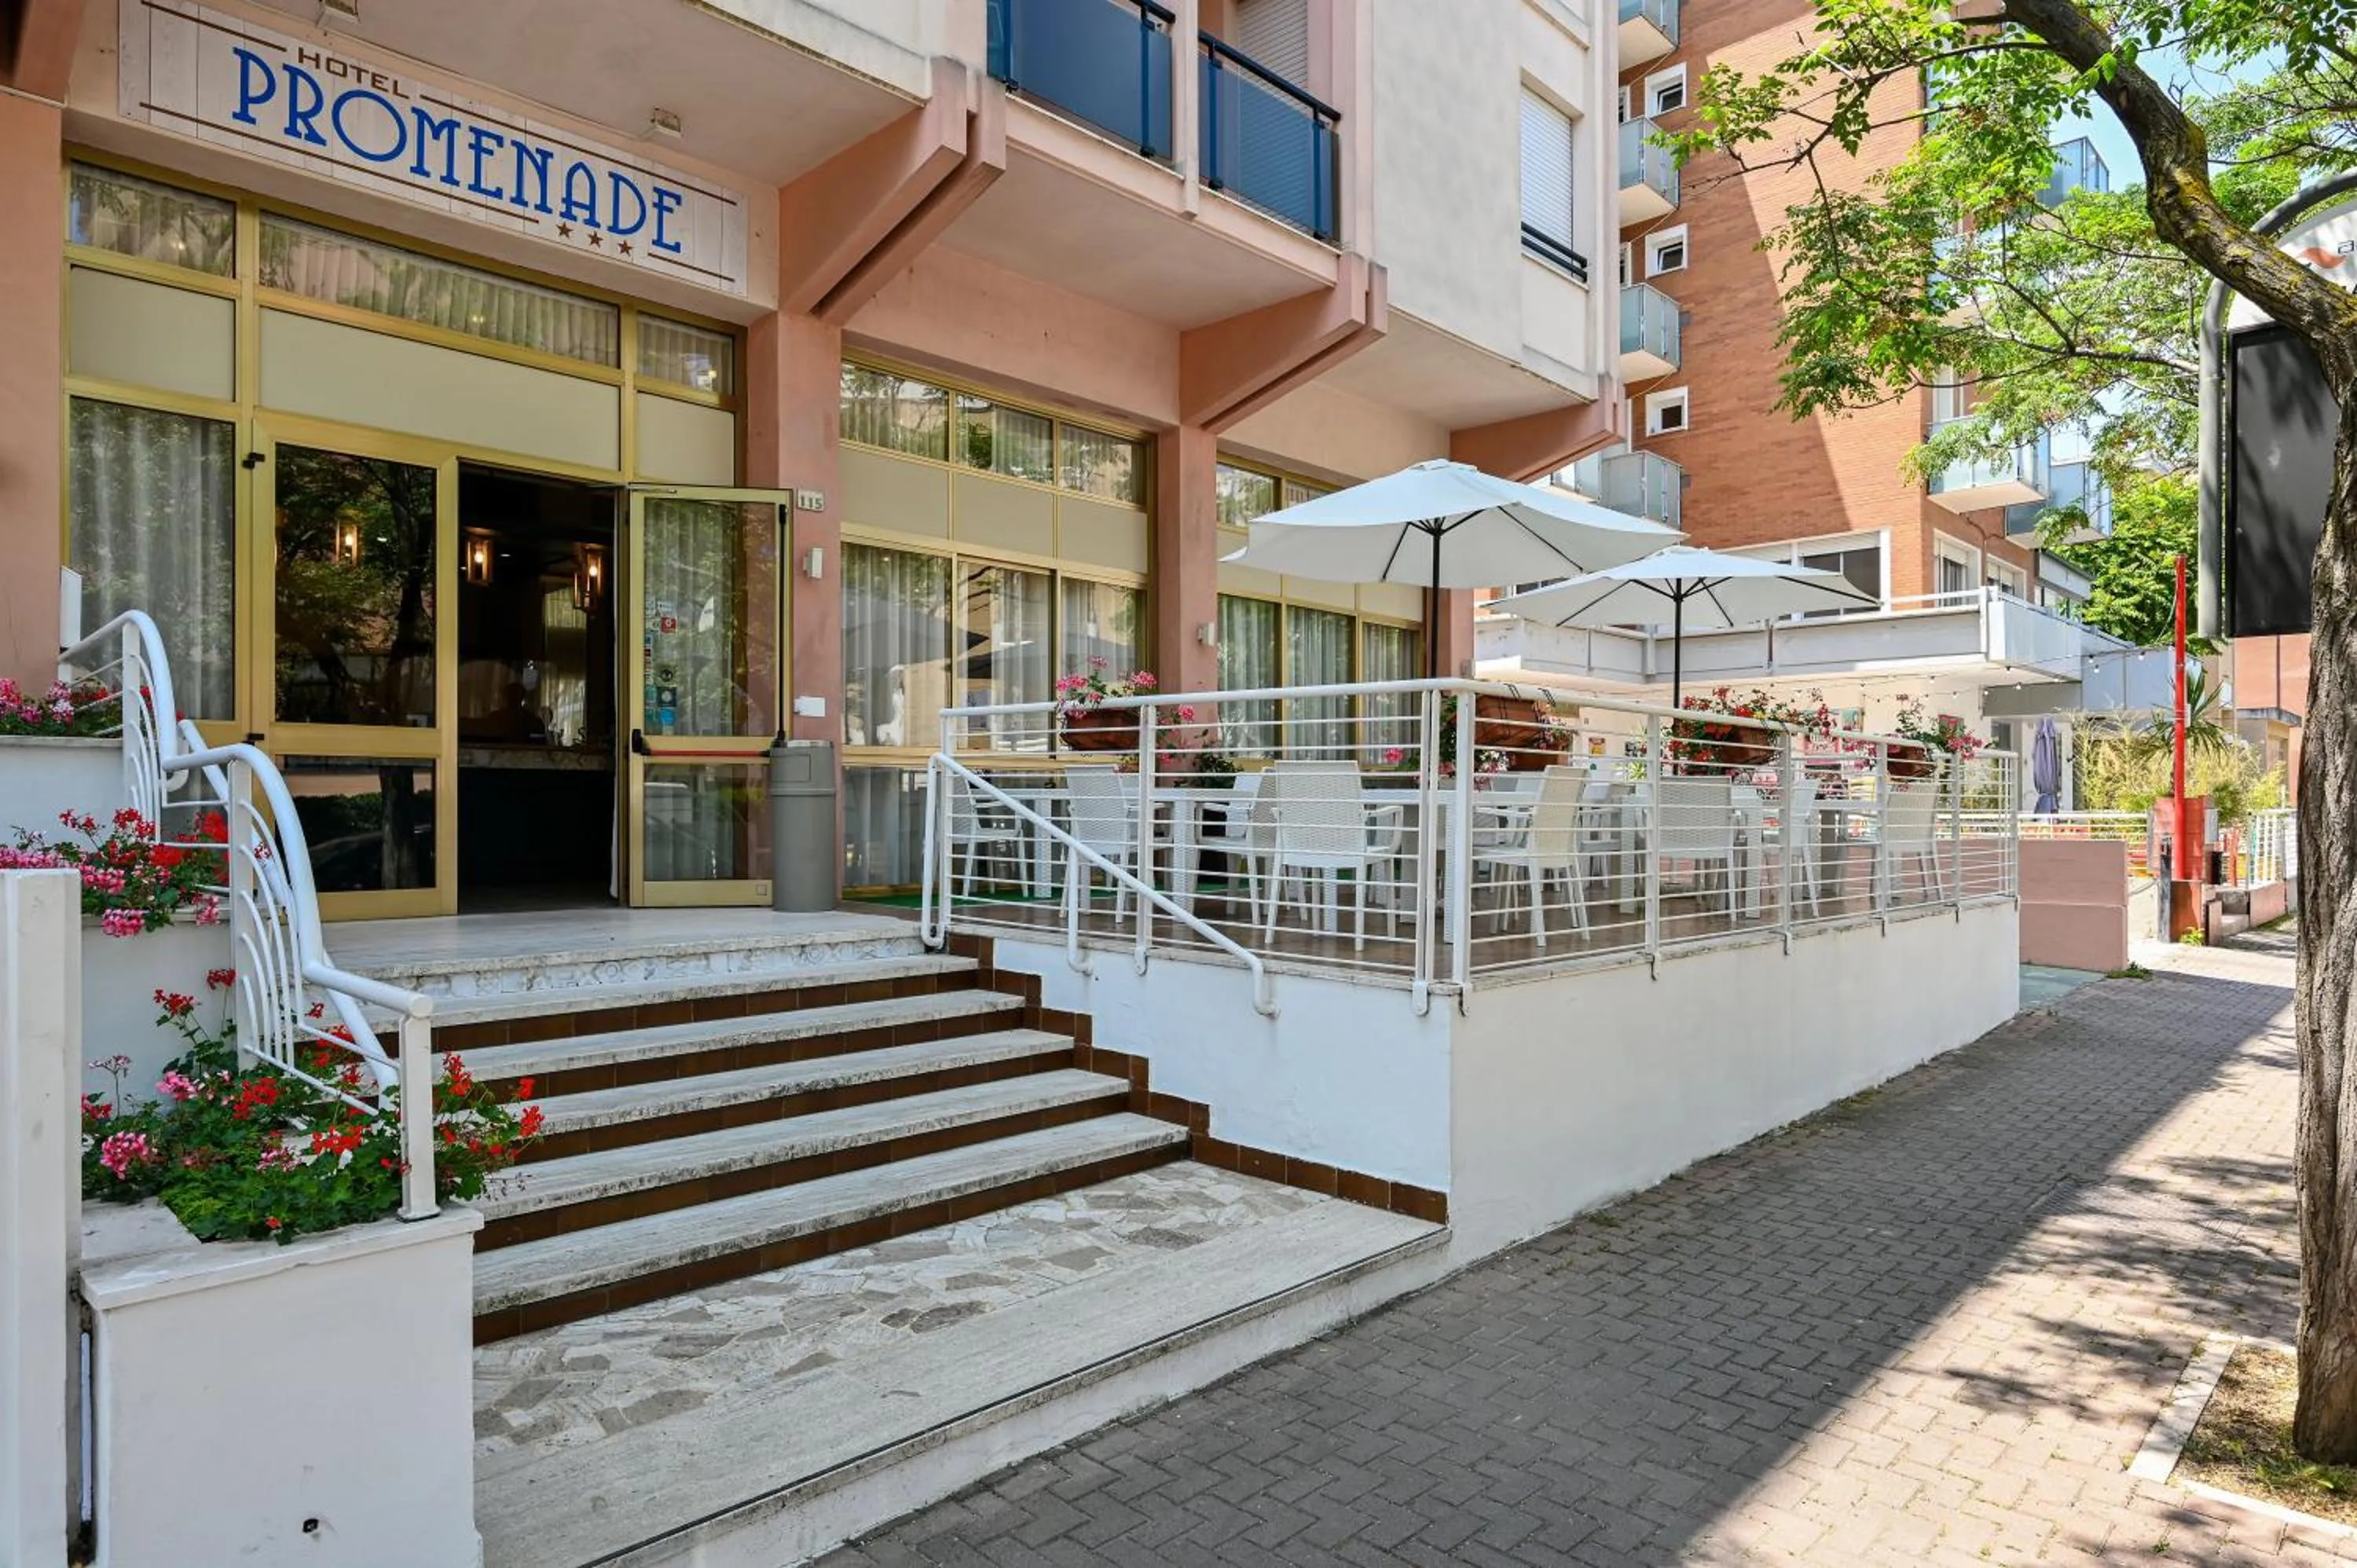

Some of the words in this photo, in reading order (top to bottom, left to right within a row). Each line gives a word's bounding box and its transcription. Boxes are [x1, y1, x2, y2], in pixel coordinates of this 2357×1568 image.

[299, 46, 410, 99] HOTEL
[233, 47, 683, 253] PROMENADE
[801, 495, 823, 509] 115
